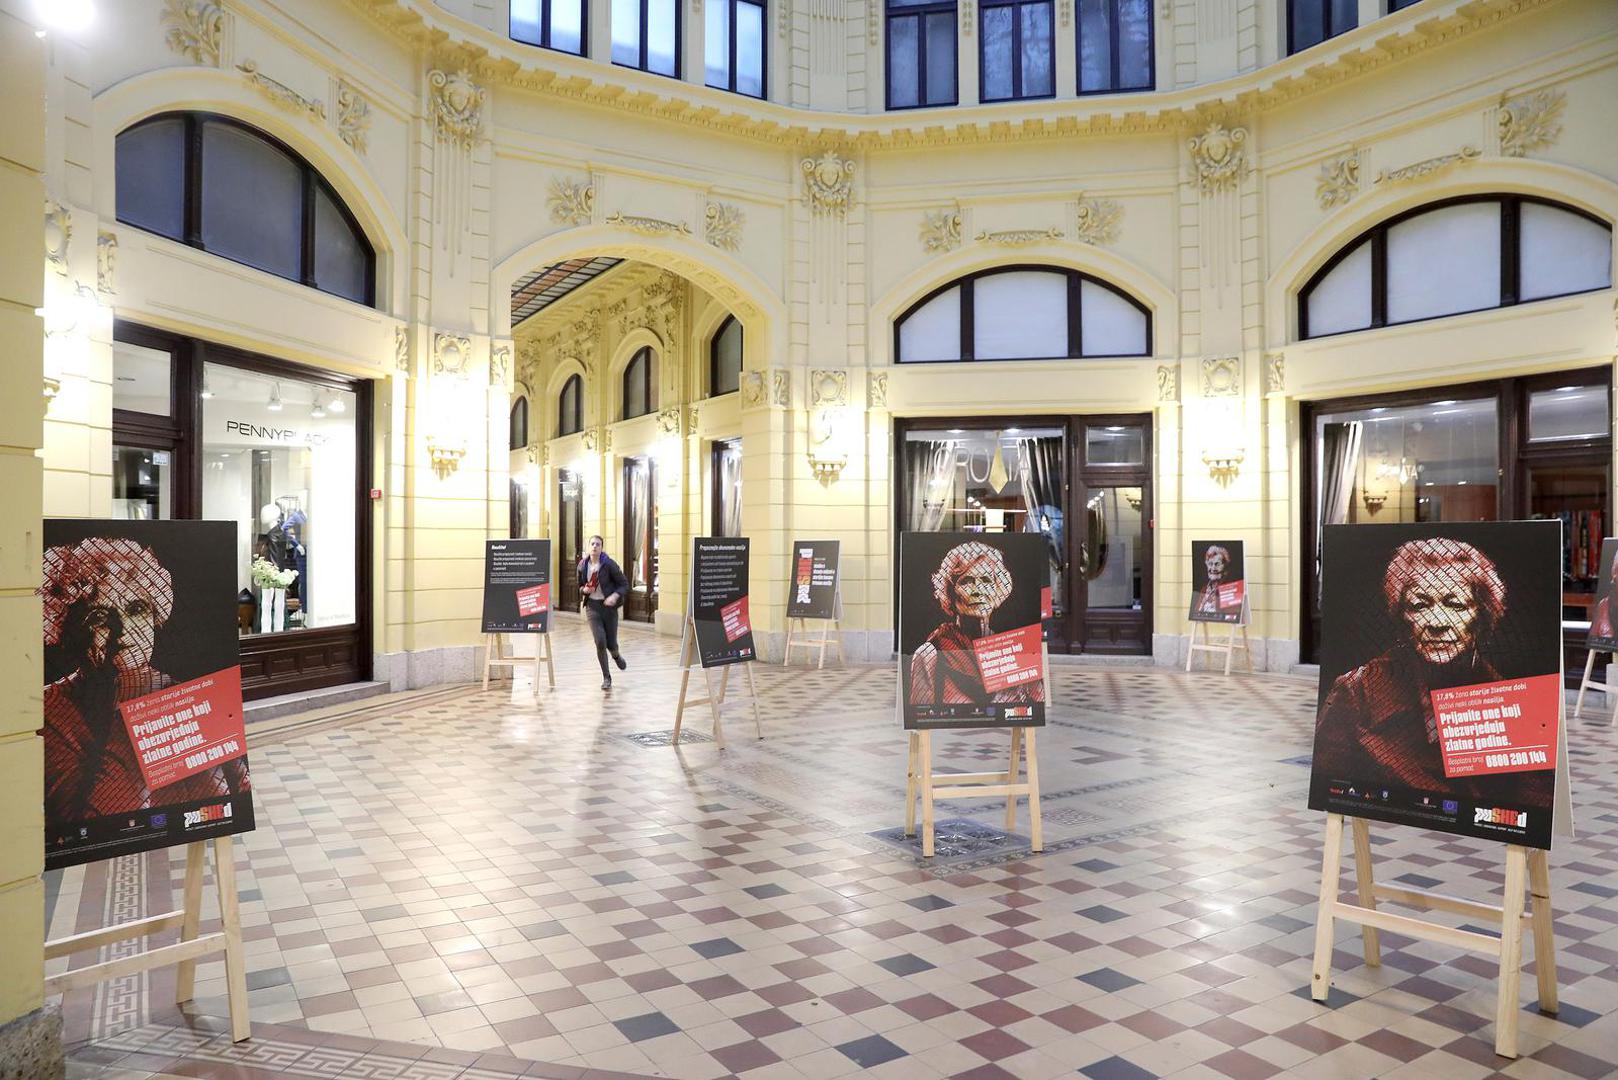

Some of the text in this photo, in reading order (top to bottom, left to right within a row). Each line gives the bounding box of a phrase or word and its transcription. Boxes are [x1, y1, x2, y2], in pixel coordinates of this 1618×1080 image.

[934, 446, 1033, 483] CROTA
[160, 691, 180, 701] starije
[201, 680, 213, 688] dobi
[1436, 692, 1454, 701] 17,8%
[1470, 687, 1490, 697] starije
[1490, 684, 1512, 694] životne
[1513, 682, 1526, 691] dobi
[132, 700, 212, 737] Prijavite one koji
[1440, 704, 1522, 725] Prijavite one koji
[142, 734, 207, 764] zlatne godine.
[1445, 735, 1512, 752] zlatne godine.
[185, 753, 207, 769] 0800
[206, 747, 225, 761] 200
[224, 740, 239, 754] 144
[1485, 754, 1509, 768] 0800
[1510, 752, 1529, 765] 200
[1529, 750, 1546, 763] 144
